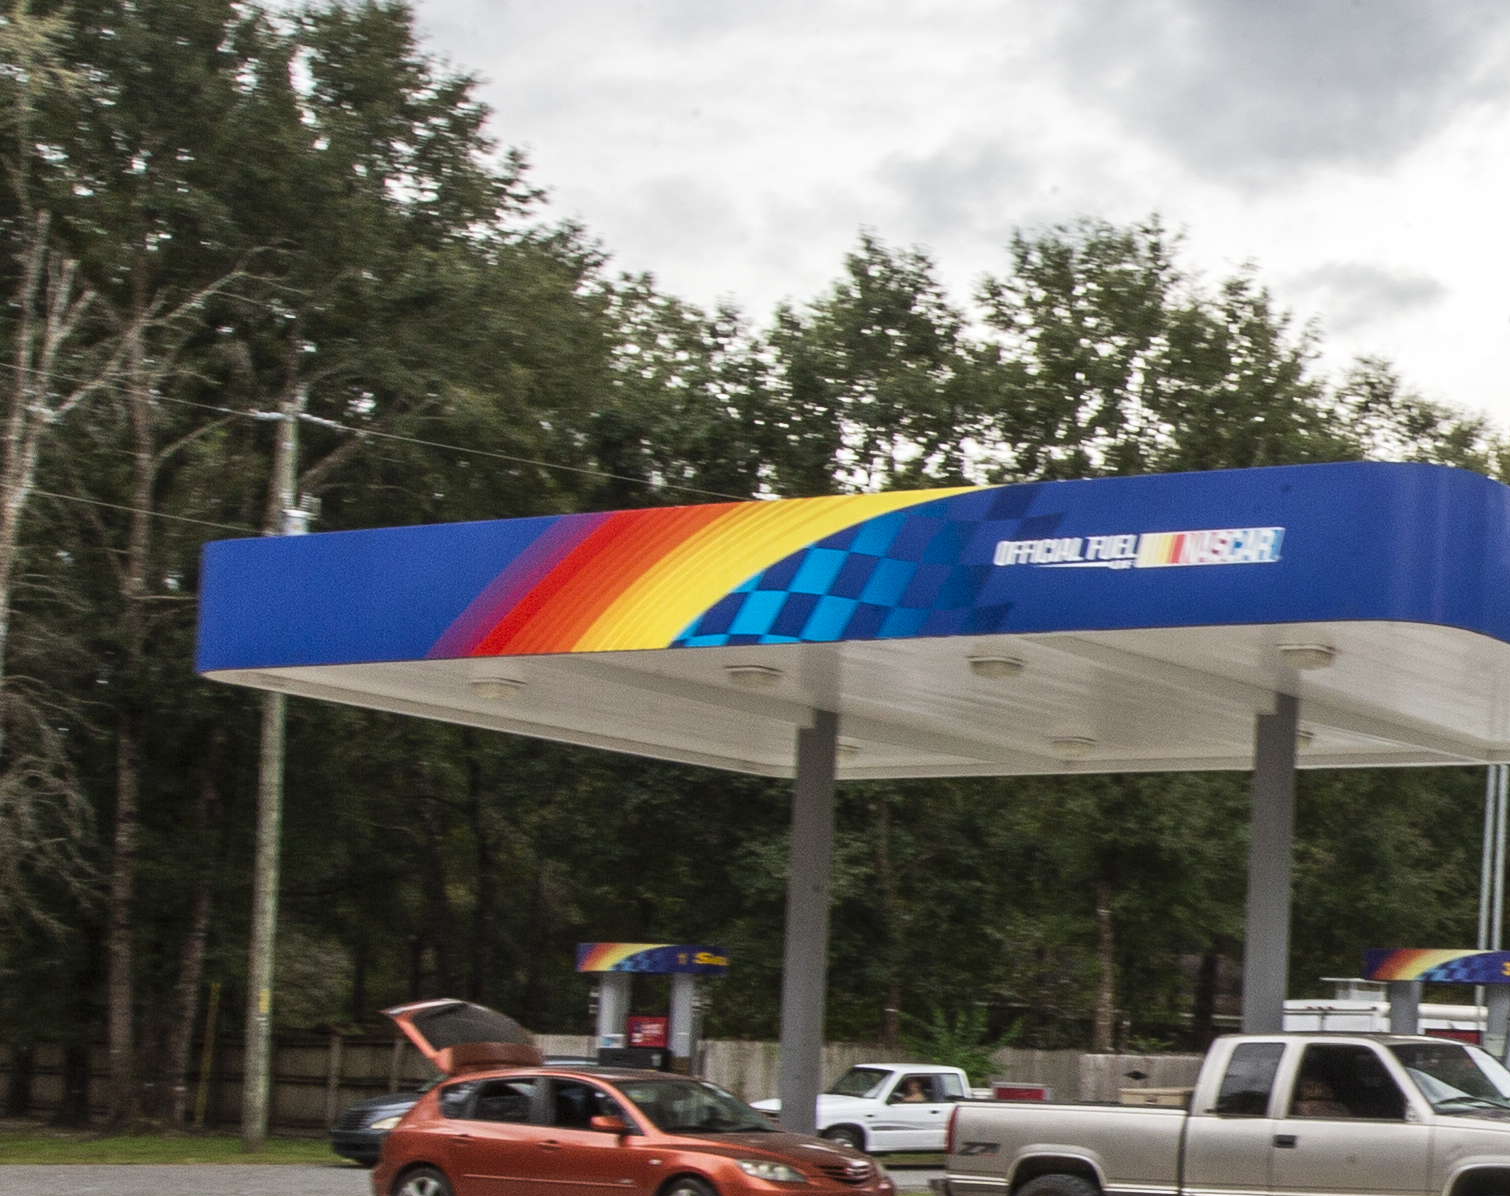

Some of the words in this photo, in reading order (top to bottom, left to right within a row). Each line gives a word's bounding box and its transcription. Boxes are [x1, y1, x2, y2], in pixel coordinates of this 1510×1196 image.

[993, 537, 1083, 565] OFFICIAL
[1084, 534, 1137, 561] FUEL
[1178, 528, 1285, 563] NASCAR
